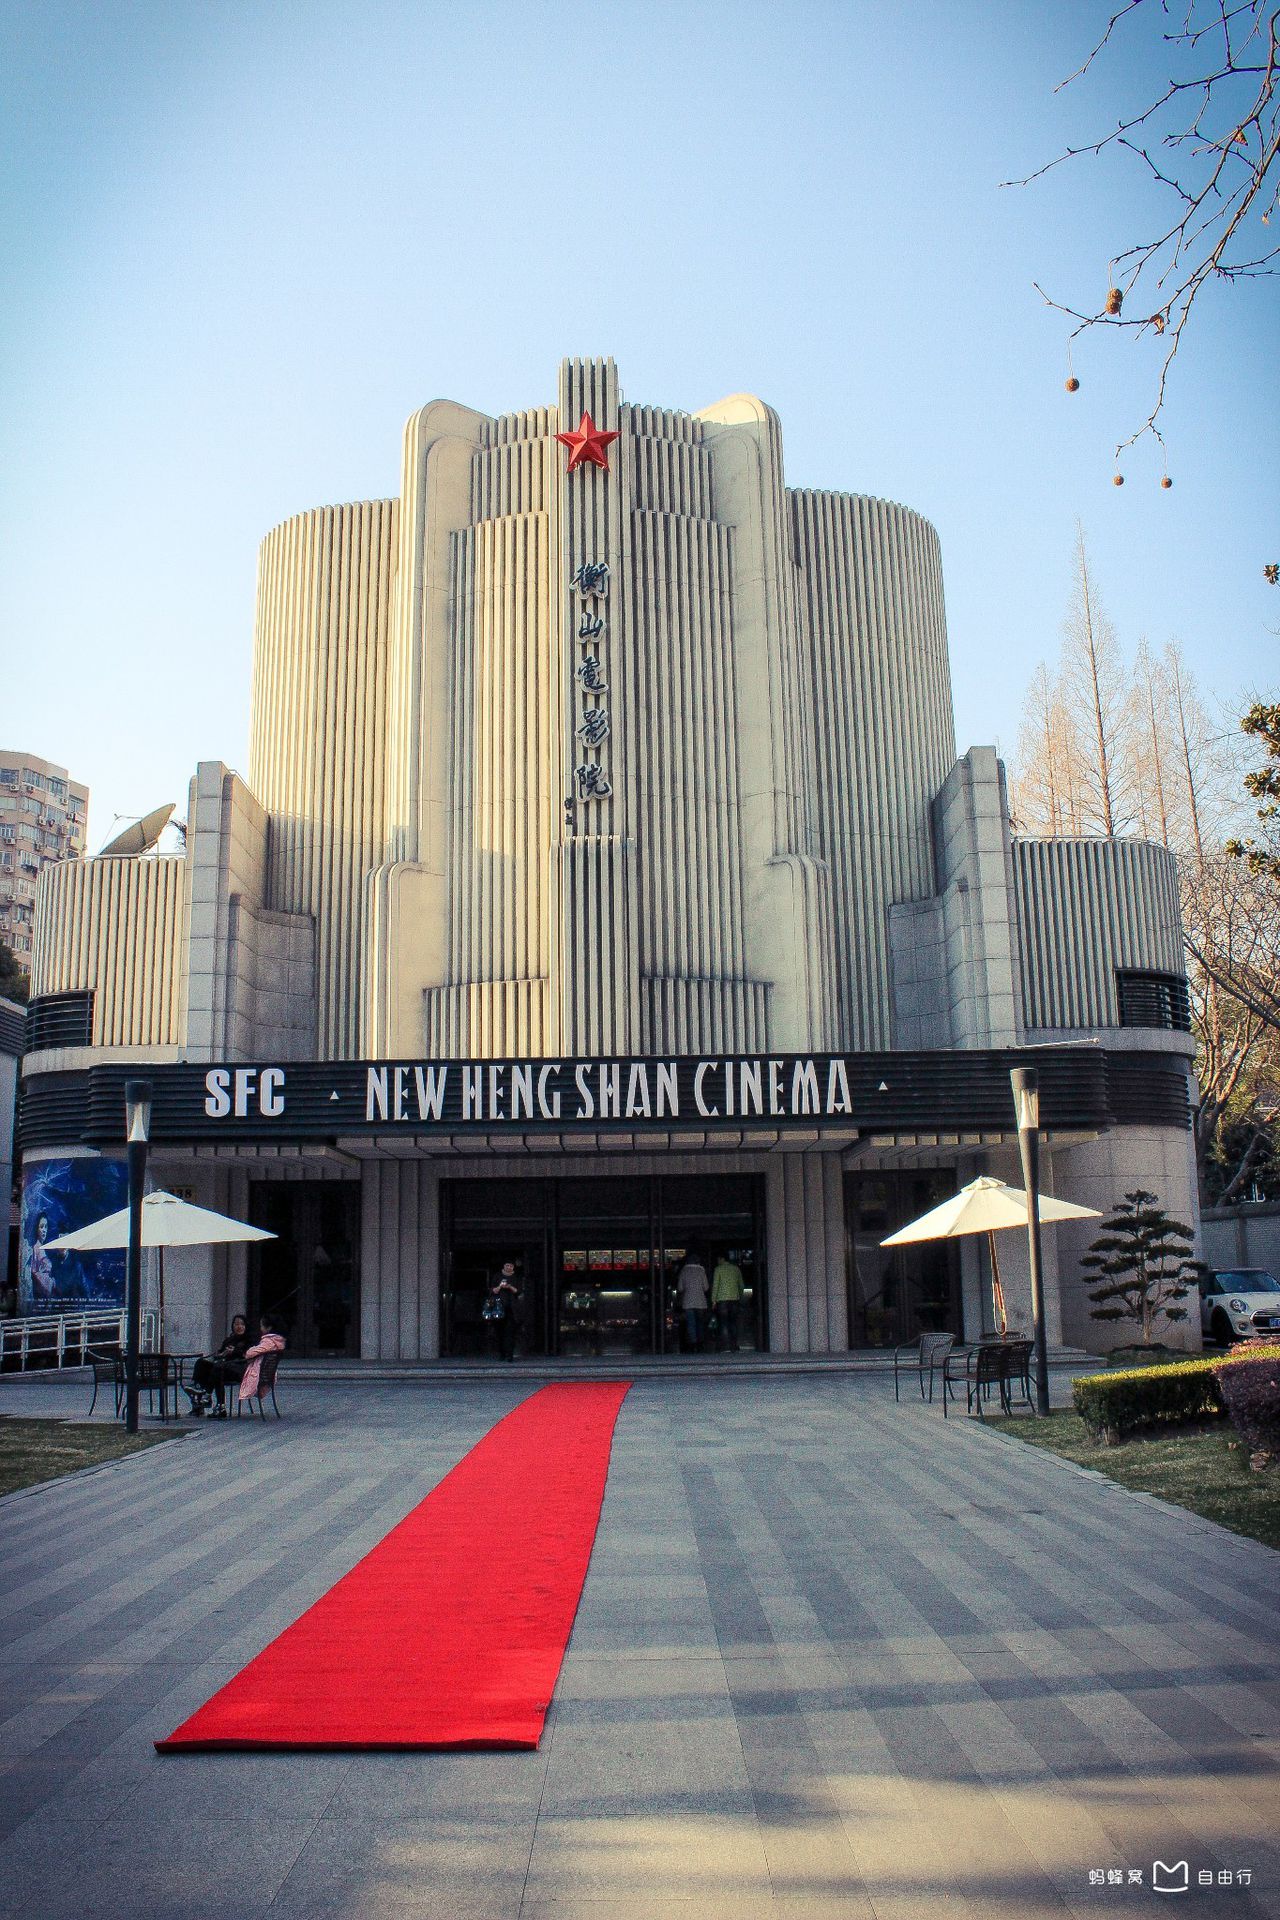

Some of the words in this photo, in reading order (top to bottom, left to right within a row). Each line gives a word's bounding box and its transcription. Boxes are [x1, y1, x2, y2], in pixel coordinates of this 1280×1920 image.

[204, 1068, 285, 1118] SFC
[366, 1066, 447, 1121] NEW
[462, 1064, 561, 1120] HENG
[575, 1062, 679, 1118] SHAN
[694, 1059, 852, 1117] CINEMA
